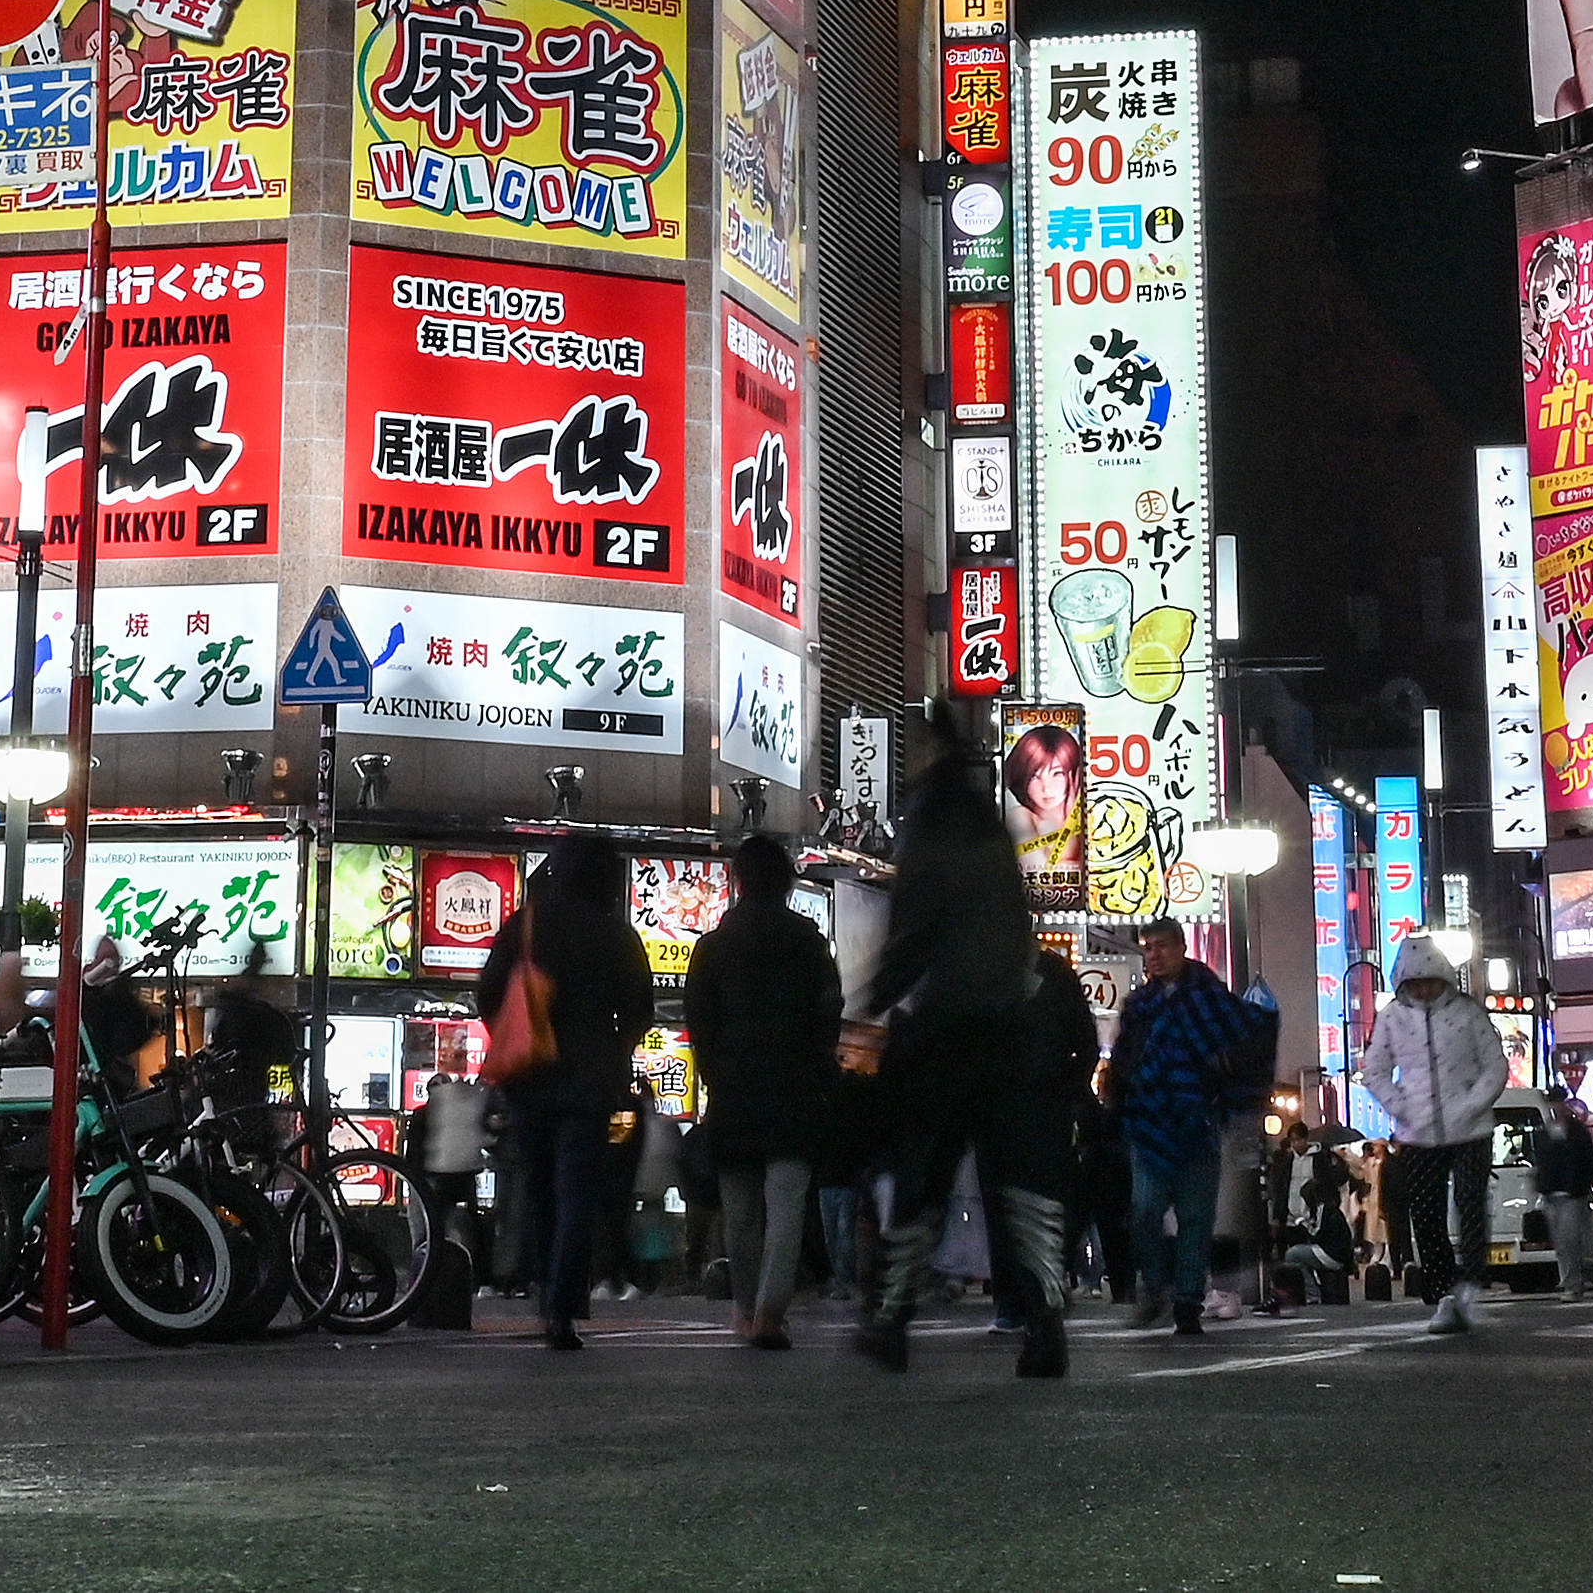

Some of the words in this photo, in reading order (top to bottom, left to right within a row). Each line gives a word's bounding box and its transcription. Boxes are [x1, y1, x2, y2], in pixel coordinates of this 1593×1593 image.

[945, 47, 1006, 66] ウェルカム
[130, 47, 290, 134] 麻雀
[380, 8, 664, 171] 麻雀
[947, 66, 1005, 150] 麻雀
[35, 149, 84, 174] 買取
[946, 150, 964, 167] 6F
[1047, 134, 1124, 188] 90
[1126, 157, 1178, 181] 円から
[369, 143, 657, 236] WELCOME
[946, 175, 965, 191] 5F
[1047, 203, 1143, 252] 寿司
[726, 201, 795, 298] ウェルカム
[393, 275, 484, 317] SINCE
[486, 284, 565, 324] 1975
[947, 273, 1011, 294] more
[1044, 258, 1133, 307] 100
[1135, 282, 1187, 304] 円から
[121, 313, 231, 348] IZAKAYA
[417, 318, 644, 377] 毎日旨くて安い店
[375, 412, 492, 487] 居酒屋
[493, 394, 661, 507] 一休
[1097, 458, 1143, 467] CHIKARA
[102, 508, 187, 544] IKKYU
[206, 506, 256, 544] 2F
[358, 502, 482, 548] IZAKAYA
[491, 515, 583, 558] IKKYU
[969, 533, 997, 553] 3F
[1060, 520, 1128, 567] 50
[605, 527, 660, 566] 2F
[781, 579, 797, 613] 2F
[123, 610, 211, 640] 焼肉
[425, 635, 489, 669] 焼肉
[501, 624, 675, 701] 叙々苑
[359, 694, 473, 725] YAKINIKU
[475, 700, 554, 730] JOJOEN
[598, 713, 628, 732] 9F
[1492, 613, 1537, 834] 山下本気うどん
[1089, 734, 1151, 779] 50
[138, 853, 195, 864] Restaurant
[199, 851, 254, 863] YAKINIKU
[254, 850, 293, 863] JOJOEN
[443, 897, 493, 914] 火鳳祥
[634, 865, 660, 928] 九十九
[657, 943, 691, 962] 299
